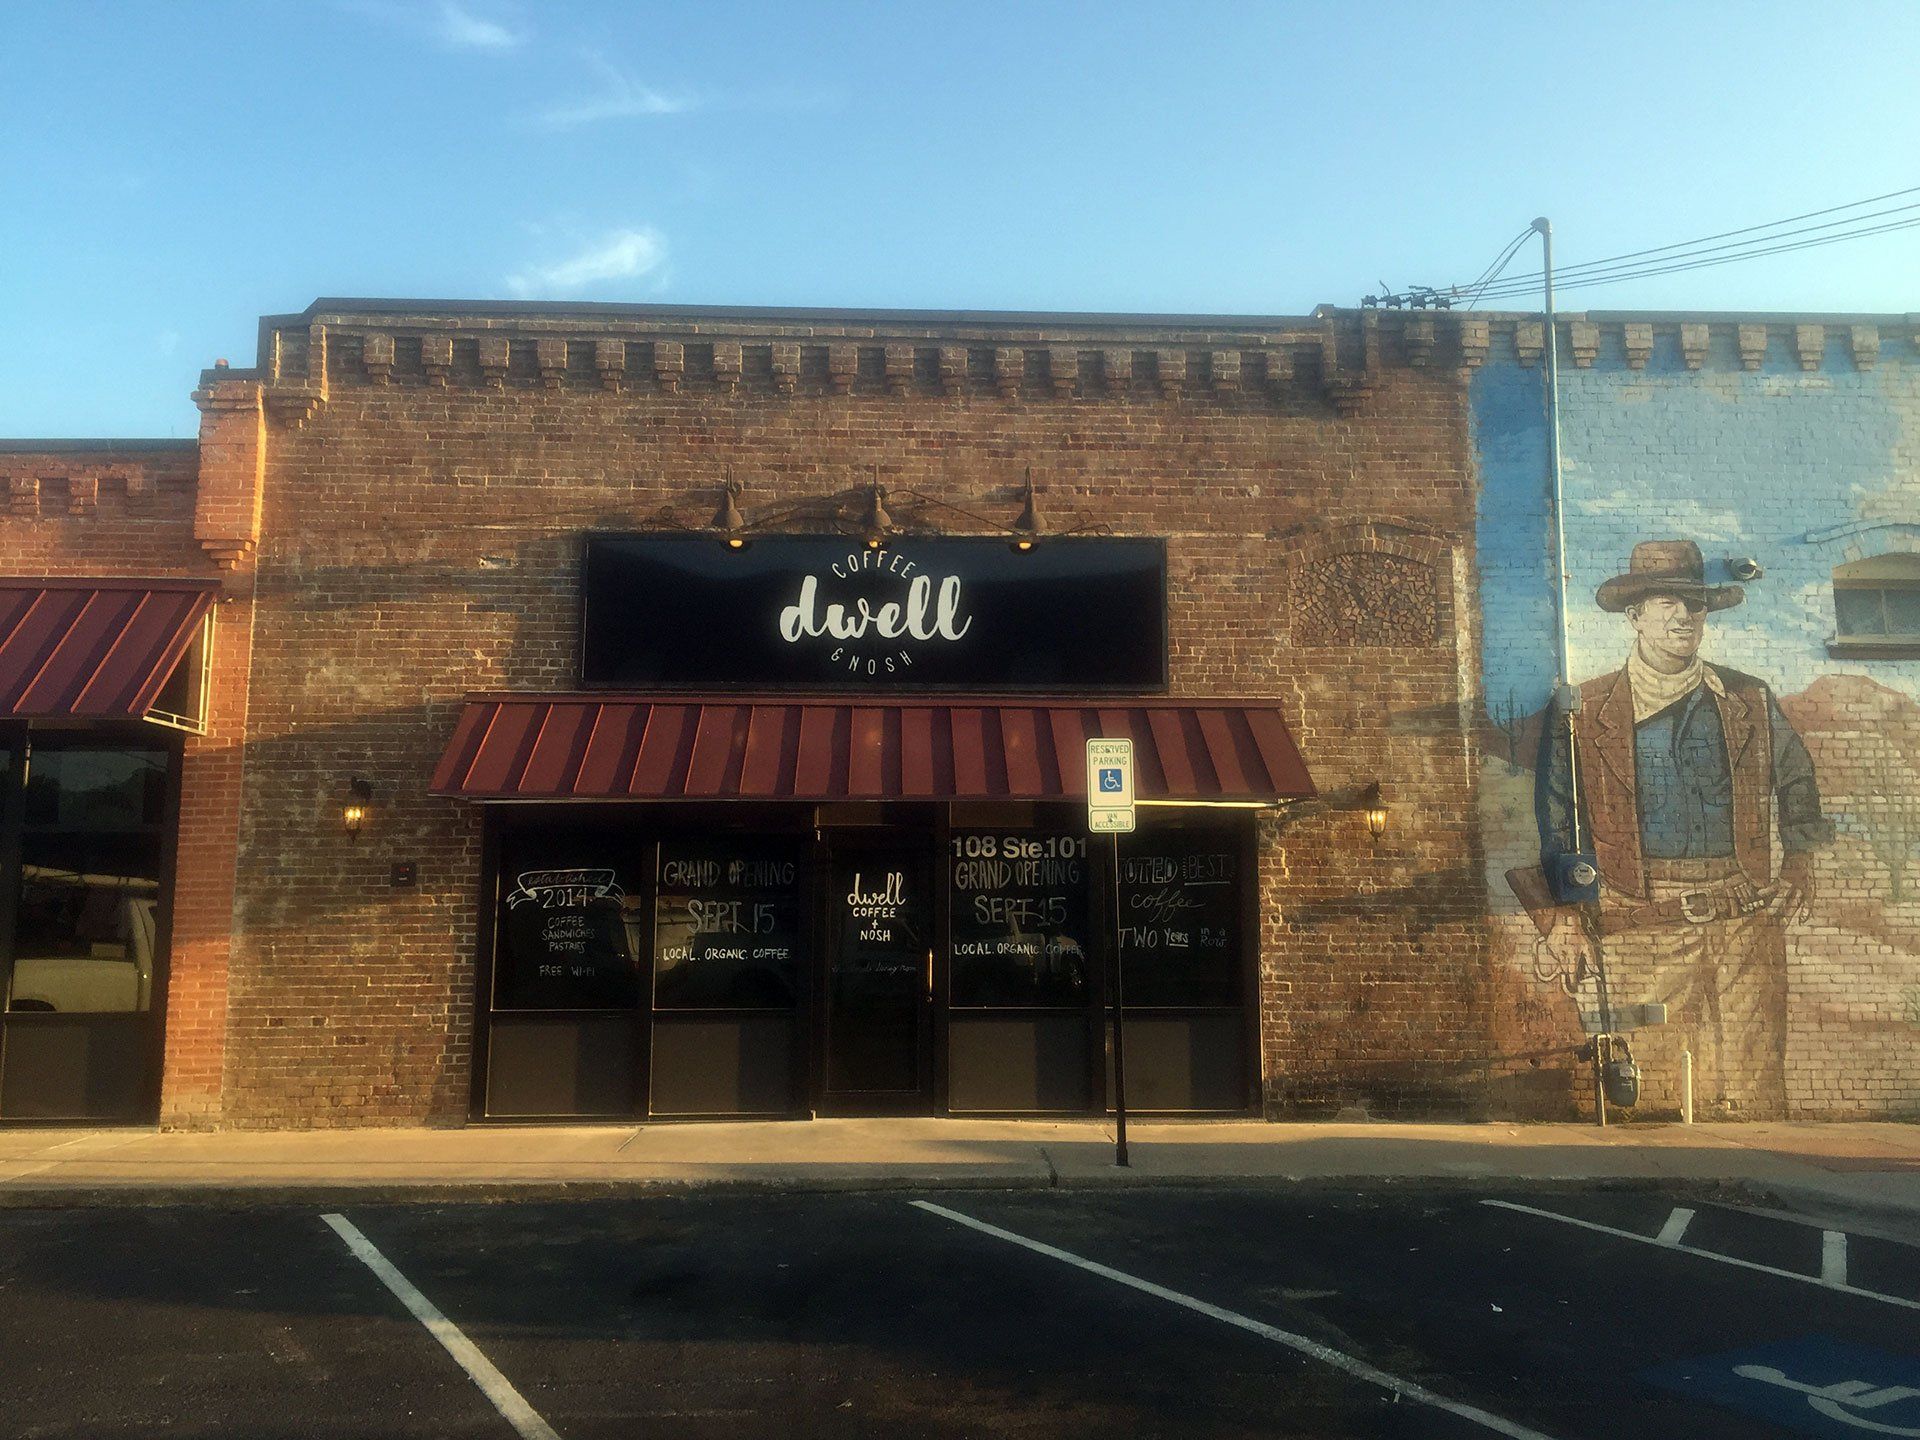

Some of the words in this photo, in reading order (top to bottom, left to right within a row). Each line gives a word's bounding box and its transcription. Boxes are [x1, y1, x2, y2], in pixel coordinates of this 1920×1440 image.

[831, 550, 916, 579] COFFEE
[779, 575, 973, 643] dwell
[848, 650, 912, 675] NOSH
[1090, 744, 1129, 754] RESERVED
[1092, 756, 1127, 766] PARKING
[1106, 812, 1118, 820] VAN
[953, 836, 997, 858] 108
[663, 860, 720, 888] GRAND
[728, 860, 795, 888] OPENING
[955, 860, 1012, 890] GRAND
[1015, 860, 1080, 887] OPENING
[1117, 857, 1178, 884] OTED
[1188, 854, 1229, 879] BEST
[542, 887, 588, 909] 2014
[847, 872, 906, 905] dwell
[852, 907, 896, 917] COFFEE
[1131, 887, 1206, 922] coffee
[547, 916, 585, 929] COFFEE
[753, 903, 775, 934] 15
[541, 928, 595, 940] SANDWICHES
[860, 929, 891, 942] NOSH
[1119, 926, 1158, 948] TWO
[539, 965, 563, 977] FREE
